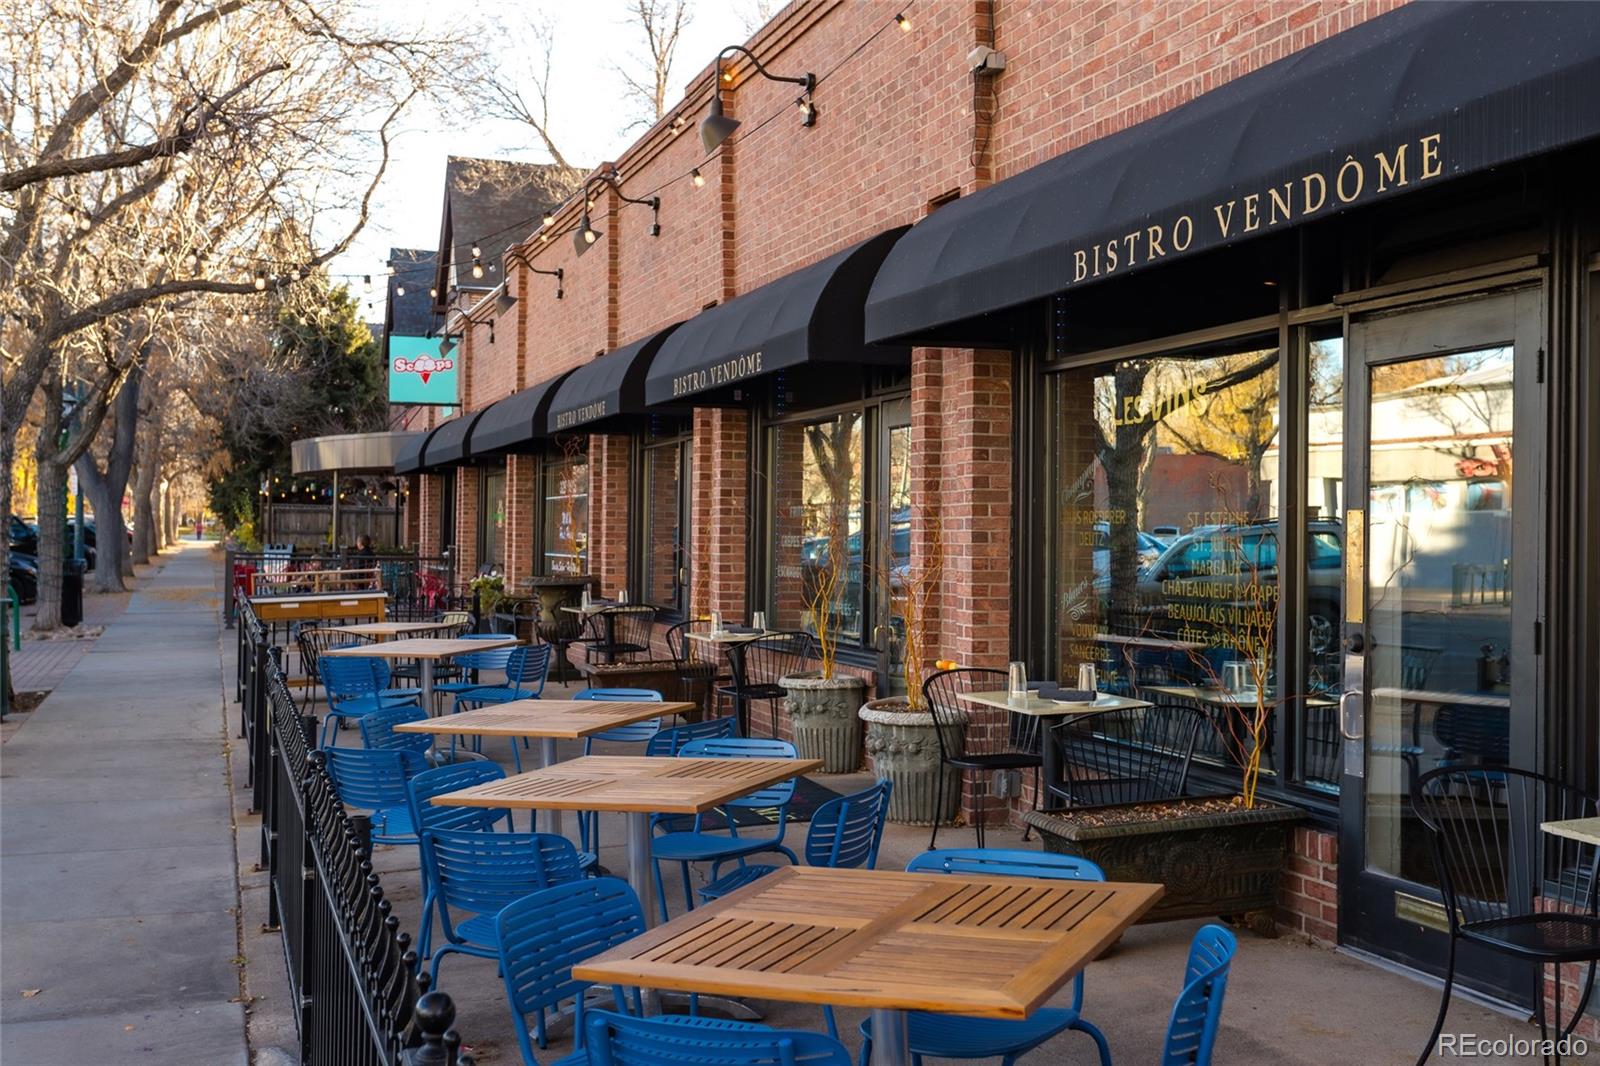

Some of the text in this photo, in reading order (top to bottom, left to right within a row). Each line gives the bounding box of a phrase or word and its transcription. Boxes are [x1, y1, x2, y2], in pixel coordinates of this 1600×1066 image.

[1073, 133, 1443, 283] BISTRO VENDÔME
[393, 353, 454, 373] Scoops
[673, 352, 763, 396] BISTRO VENDÔME
[1114, 376, 1208, 426] LES VINS
[557, 410, 577, 430] BISTRO
[1191, 559, 1243, 577] MARGAUX
[1161, 576, 1233, 599] CHÂTEAUNEUF
[1167, 603, 1226, 624] BEAUJOLAIS
[1070, 644, 1111, 660] SANCERRE
